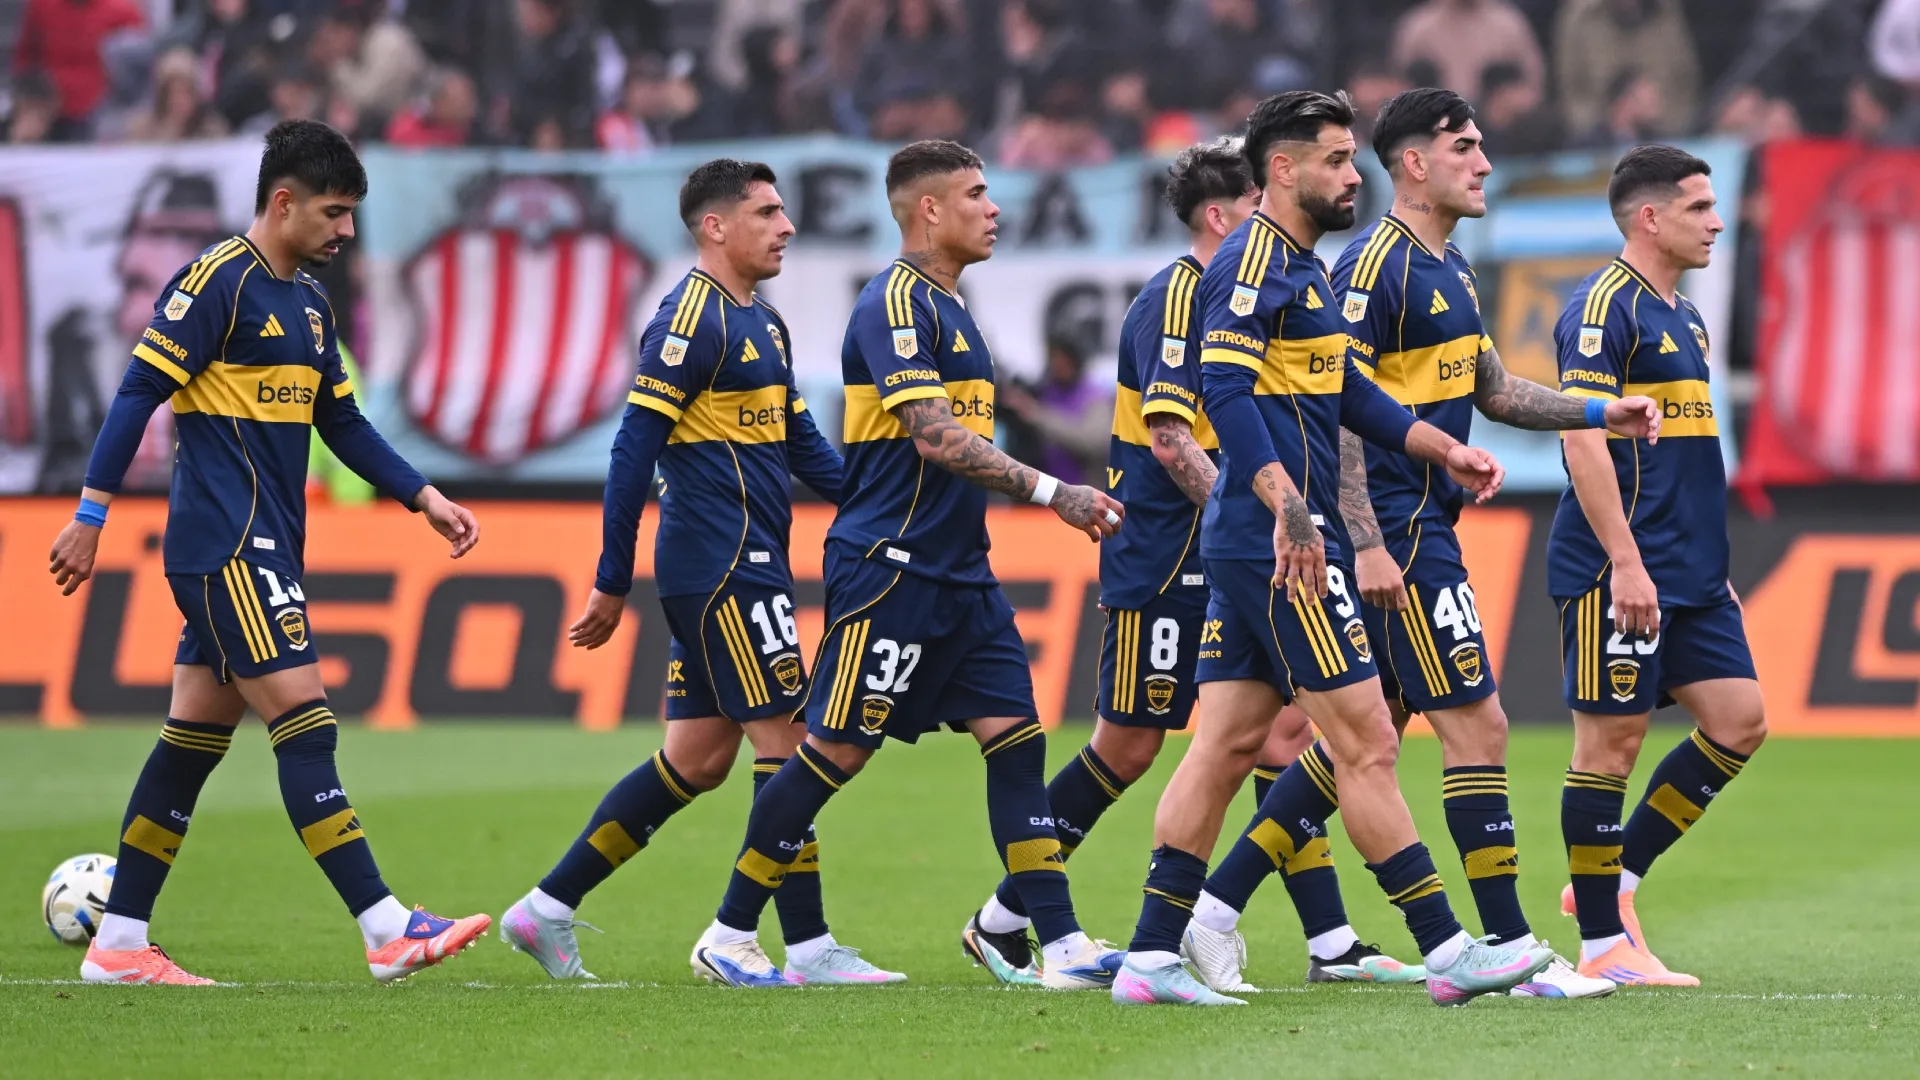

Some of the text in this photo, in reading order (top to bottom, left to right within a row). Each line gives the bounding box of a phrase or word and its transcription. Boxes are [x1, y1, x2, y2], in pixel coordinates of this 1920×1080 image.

[143, 327, 188, 362] ETROGAR
[1206, 330, 1265, 354] CETROGAR
[635, 374, 687, 404] CETROGAR
[885, 369, 941, 388] CETROGAR
[1146, 381, 1196, 405] CETROGAR
[1562, 369, 1617, 388] CETROGAR
[1327, 565, 1356, 619] 9
[751, 593, 798, 655] 16
[1433, 581, 1482, 641] 40
[1150, 617, 1180, 670] 8
[865, 638, 922, 693] 32
[1460, 658, 1478, 669] CABJ
[866, 709, 884, 718] CABJ
